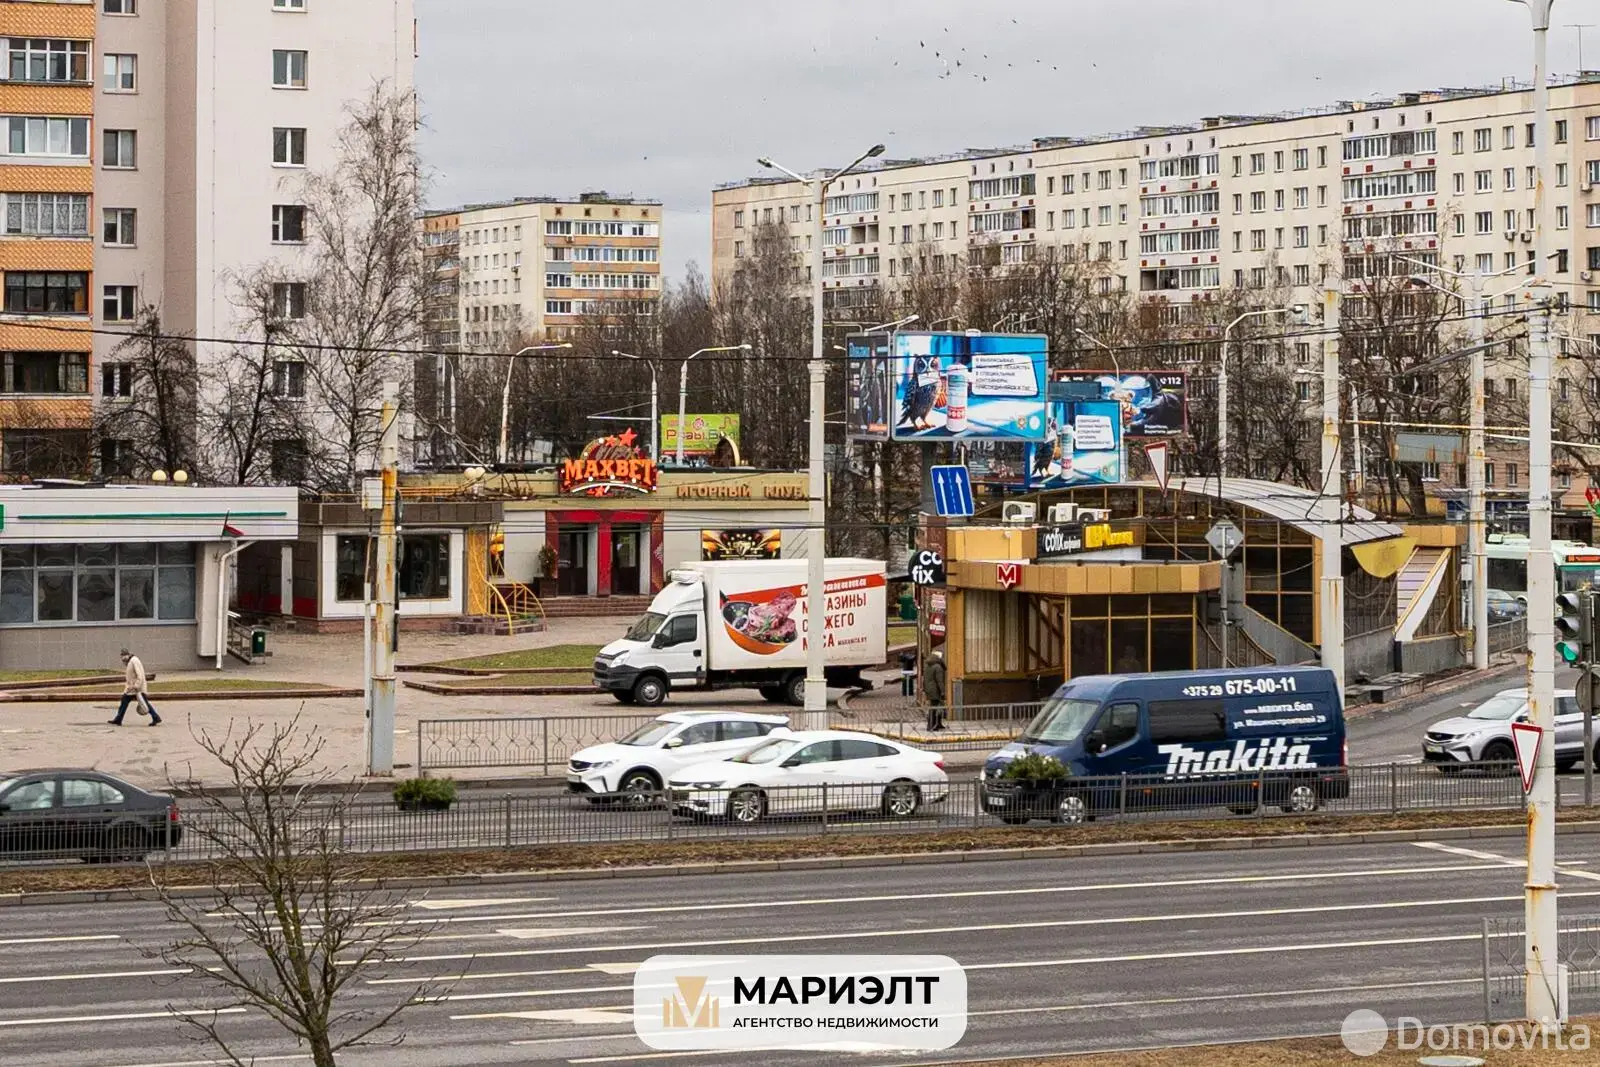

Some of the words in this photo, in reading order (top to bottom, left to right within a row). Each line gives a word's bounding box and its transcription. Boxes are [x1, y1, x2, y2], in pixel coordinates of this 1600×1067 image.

[564, 459, 656, 486] MAXBET
[677, 483, 752, 498] ИГОРНЫЙ
[764, 483, 804, 498] КЛУБ
[912, 566, 934, 584] fix
[802, 593, 867, 614] МАЗИНЫ
[802, 612, 854, 632] СЖЕГО
[1182, 686, 1208, 696] +375
[1210, 686, 1224, 696] 29
[1225, 676, 1296, 695] 675-00-11
